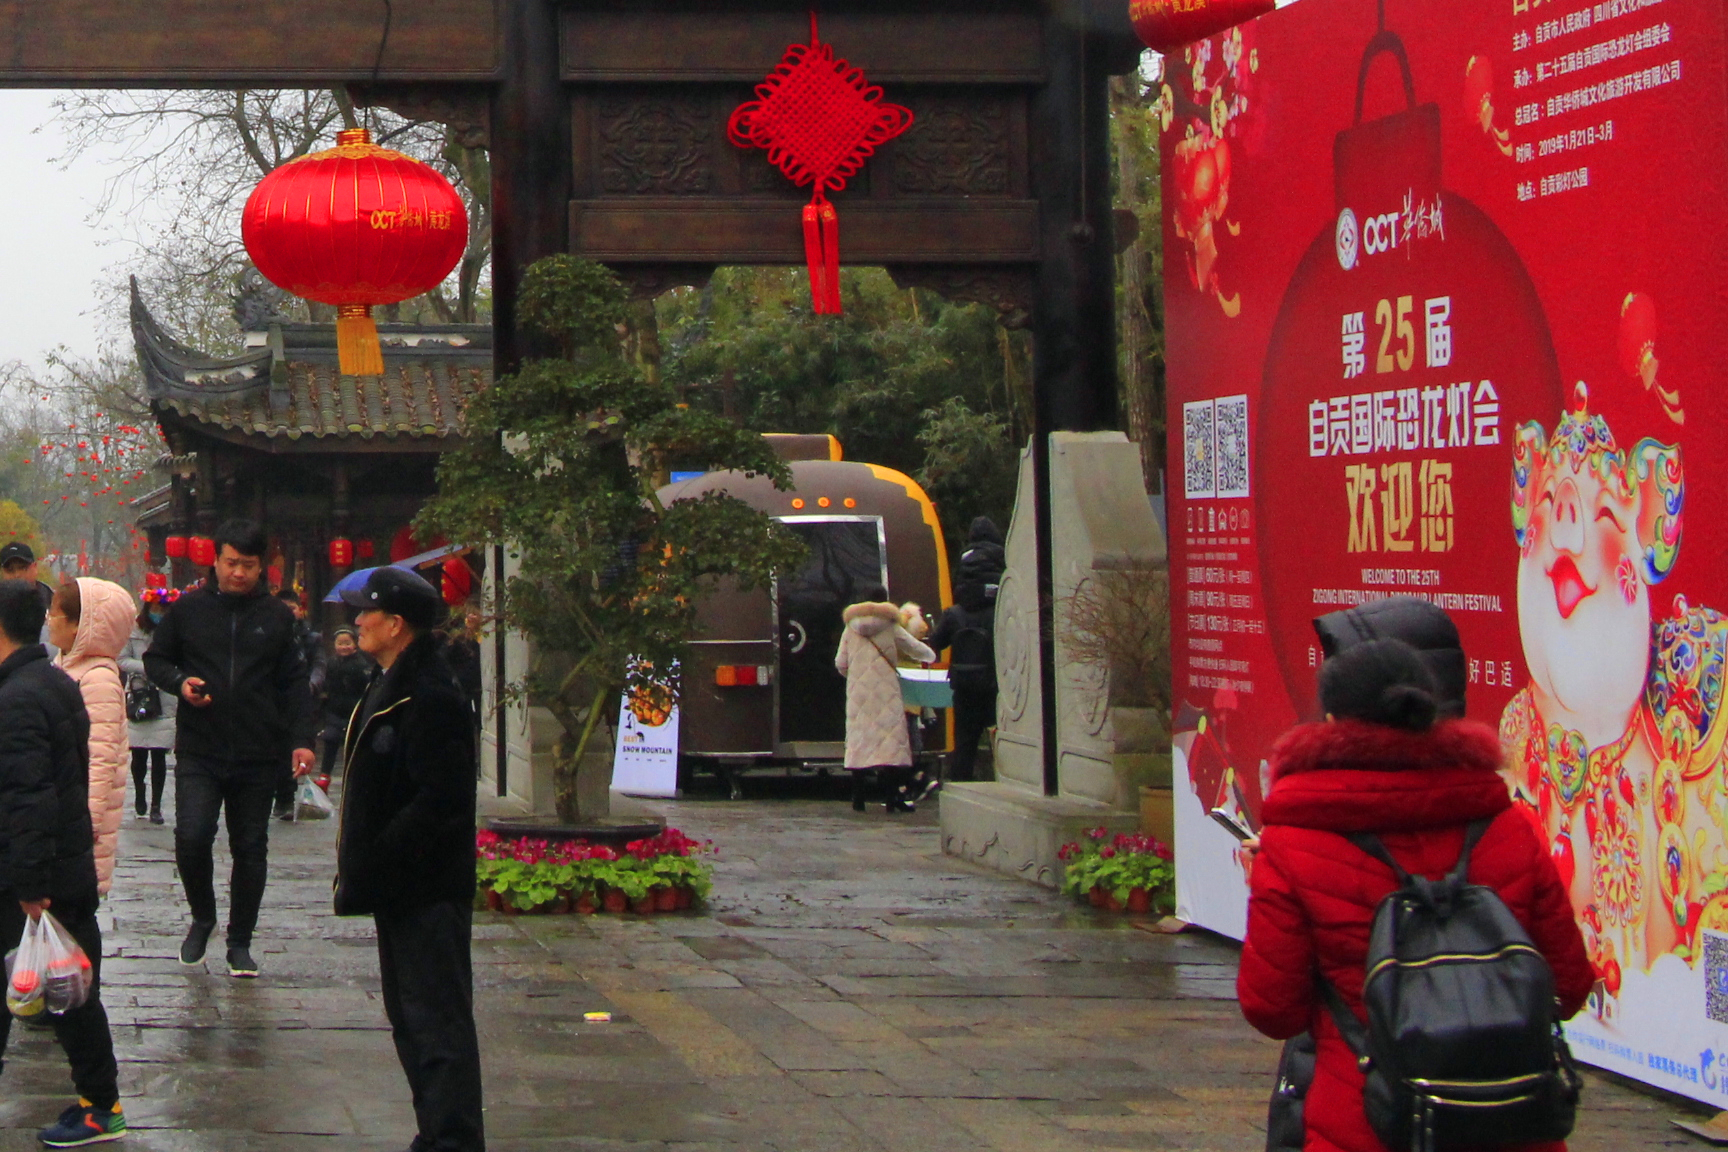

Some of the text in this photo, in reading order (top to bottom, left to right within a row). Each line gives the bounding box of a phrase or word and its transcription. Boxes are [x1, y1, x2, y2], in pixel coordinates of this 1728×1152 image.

[370, 210, 397, 230] OCT
[1363, 211, 1399, 255] OCT
[1308, 379, 1500, 457] 自贡国际恐龙灯会
[1345, 459, 1454, 553] 欢迎您
[1361, 568, 1440, 586] WELCOME TO THE 25TH
[1312, 588, 1337, 604] ZIGONG
[1464, 594, 1503, 612] FESTIVAL
[641, 746, 673, 755] MOUNTAIN
